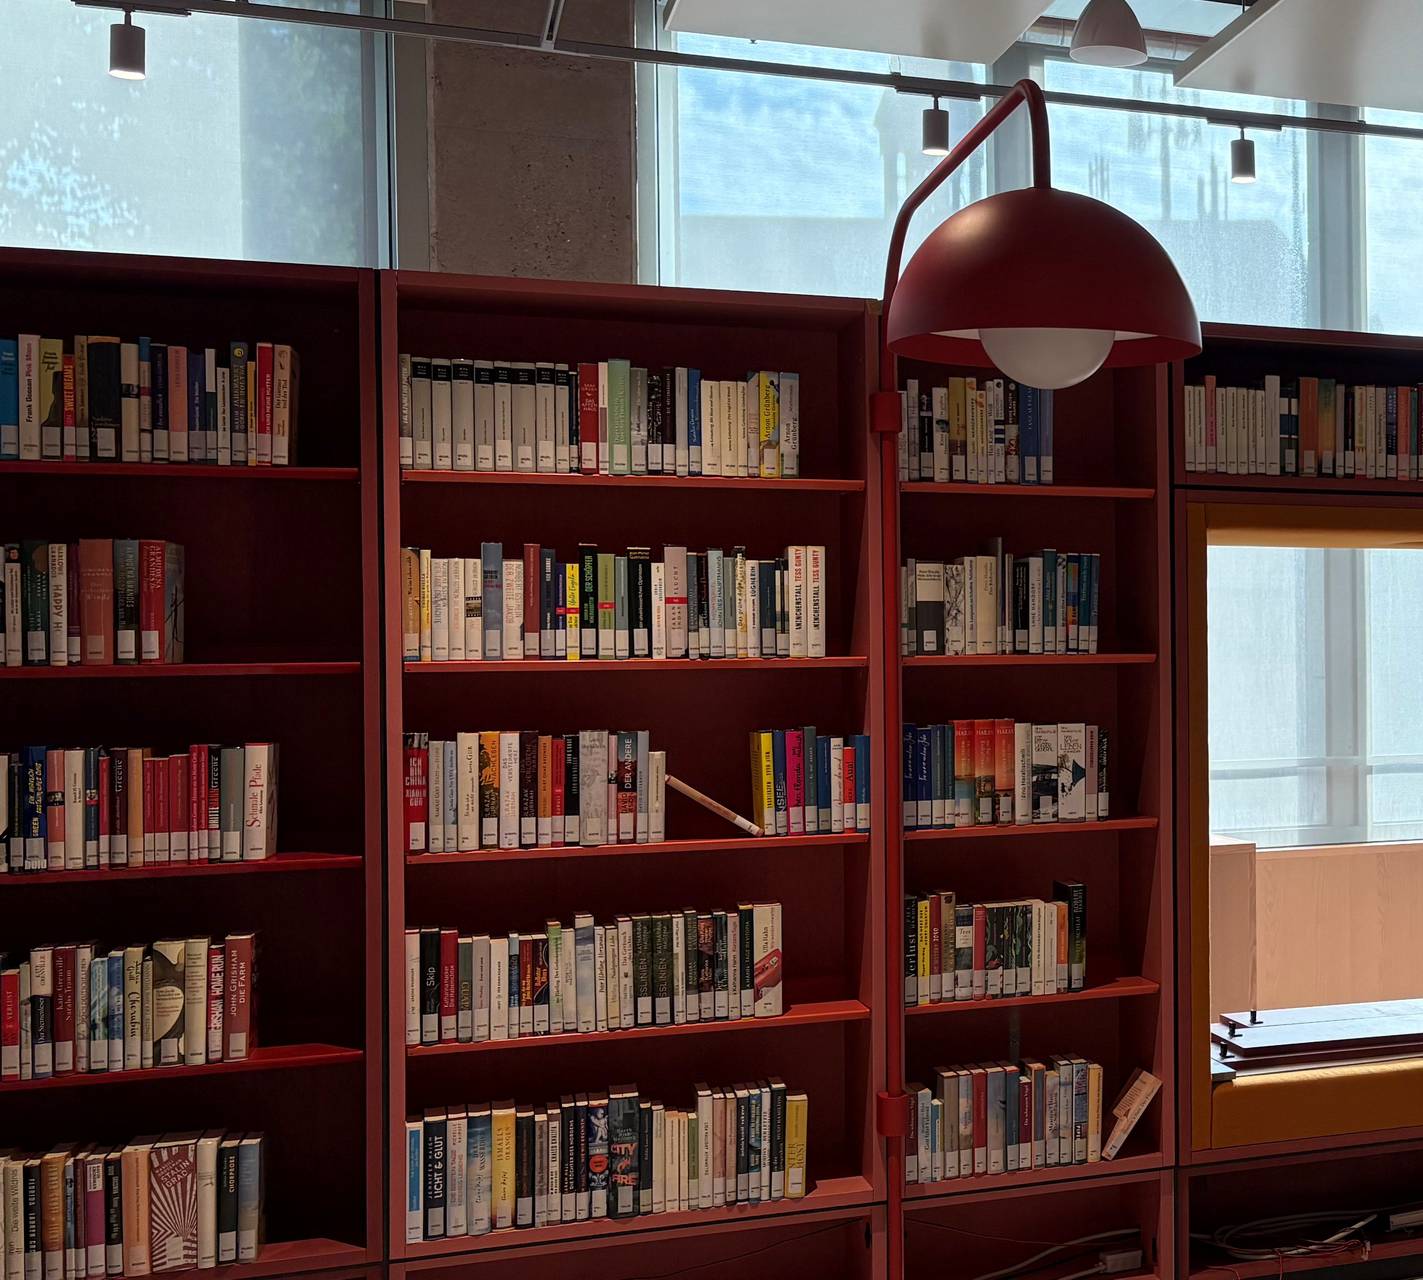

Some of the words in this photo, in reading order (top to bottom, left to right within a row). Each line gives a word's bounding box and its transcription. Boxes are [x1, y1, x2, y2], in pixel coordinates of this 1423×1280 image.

[623, 738, 632, 771] ANDERE
[624, 773, 632, 789] DER
[426, 967, 436, 987] Skip
[433, 1135, 443, 1160] GLUT
[433, 1171, 444, 1200] LICHT
